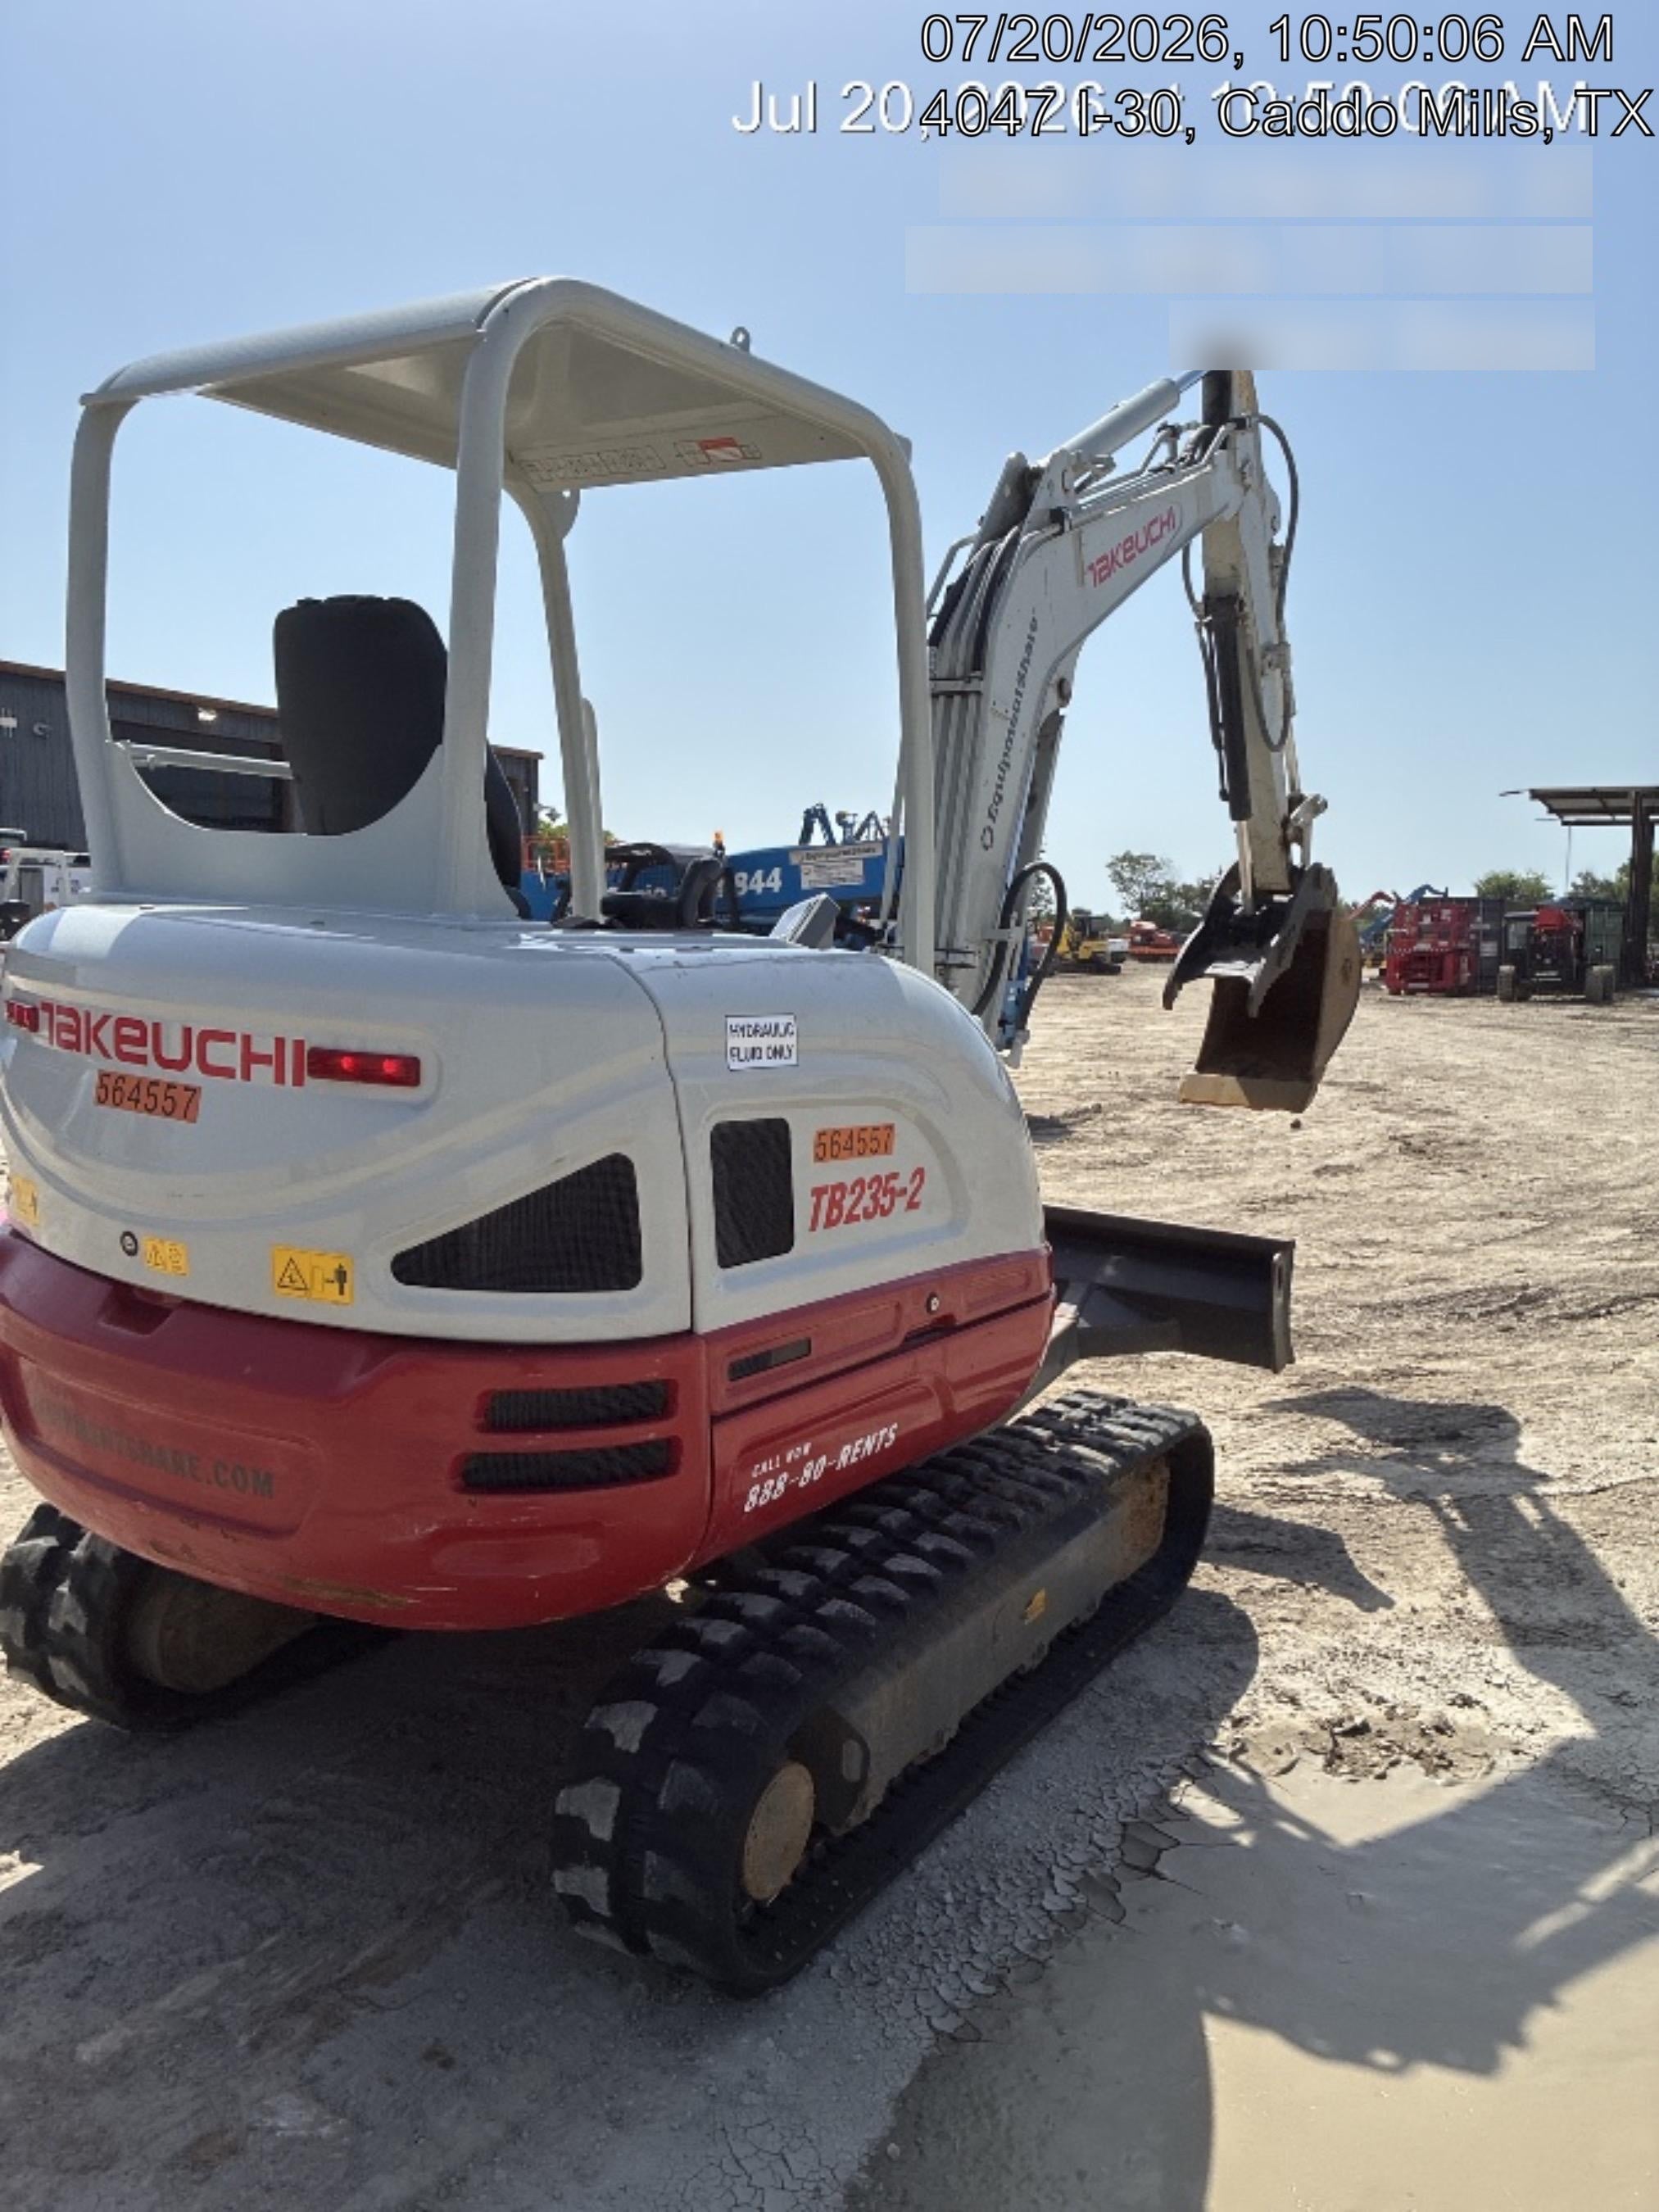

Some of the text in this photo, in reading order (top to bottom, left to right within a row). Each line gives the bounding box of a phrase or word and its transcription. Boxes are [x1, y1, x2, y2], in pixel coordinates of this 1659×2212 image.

[729, 1022, 795, 1038] HYDRAULIC
[729, 1044, 795, 1063] FLUID ONLY
[96, 1072, 197, 1120] 564557
[815, 1123, 894, 1163] 564557
[809, 1167, 926, 1232] TB235-2
[744, 1422, 899, 1513] 888-80-RENTS
[751, 1454, 781, 1478] CALL
